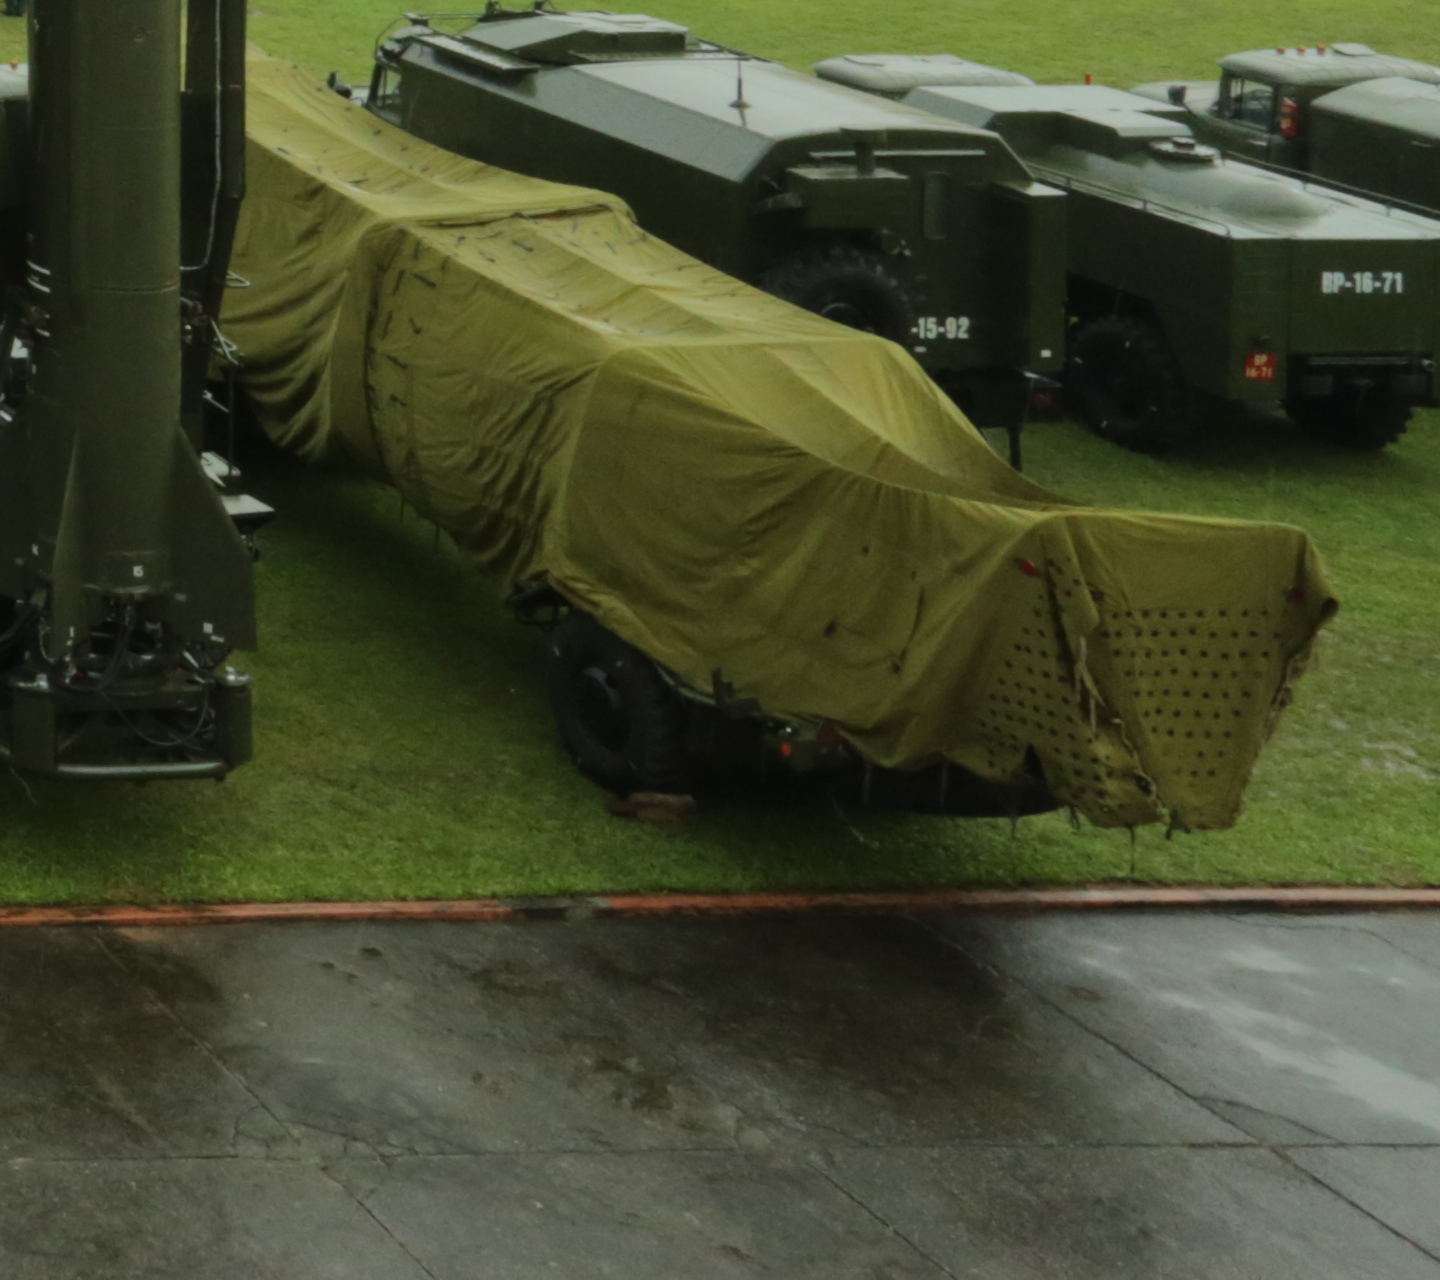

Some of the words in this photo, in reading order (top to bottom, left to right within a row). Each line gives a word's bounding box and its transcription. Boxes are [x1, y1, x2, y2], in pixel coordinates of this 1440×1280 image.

[1321, 271, 1404, 294] BP-16-71
[1254, 354, 1268, 366] BP
[1245, 367, 1273, 378] 16-71
